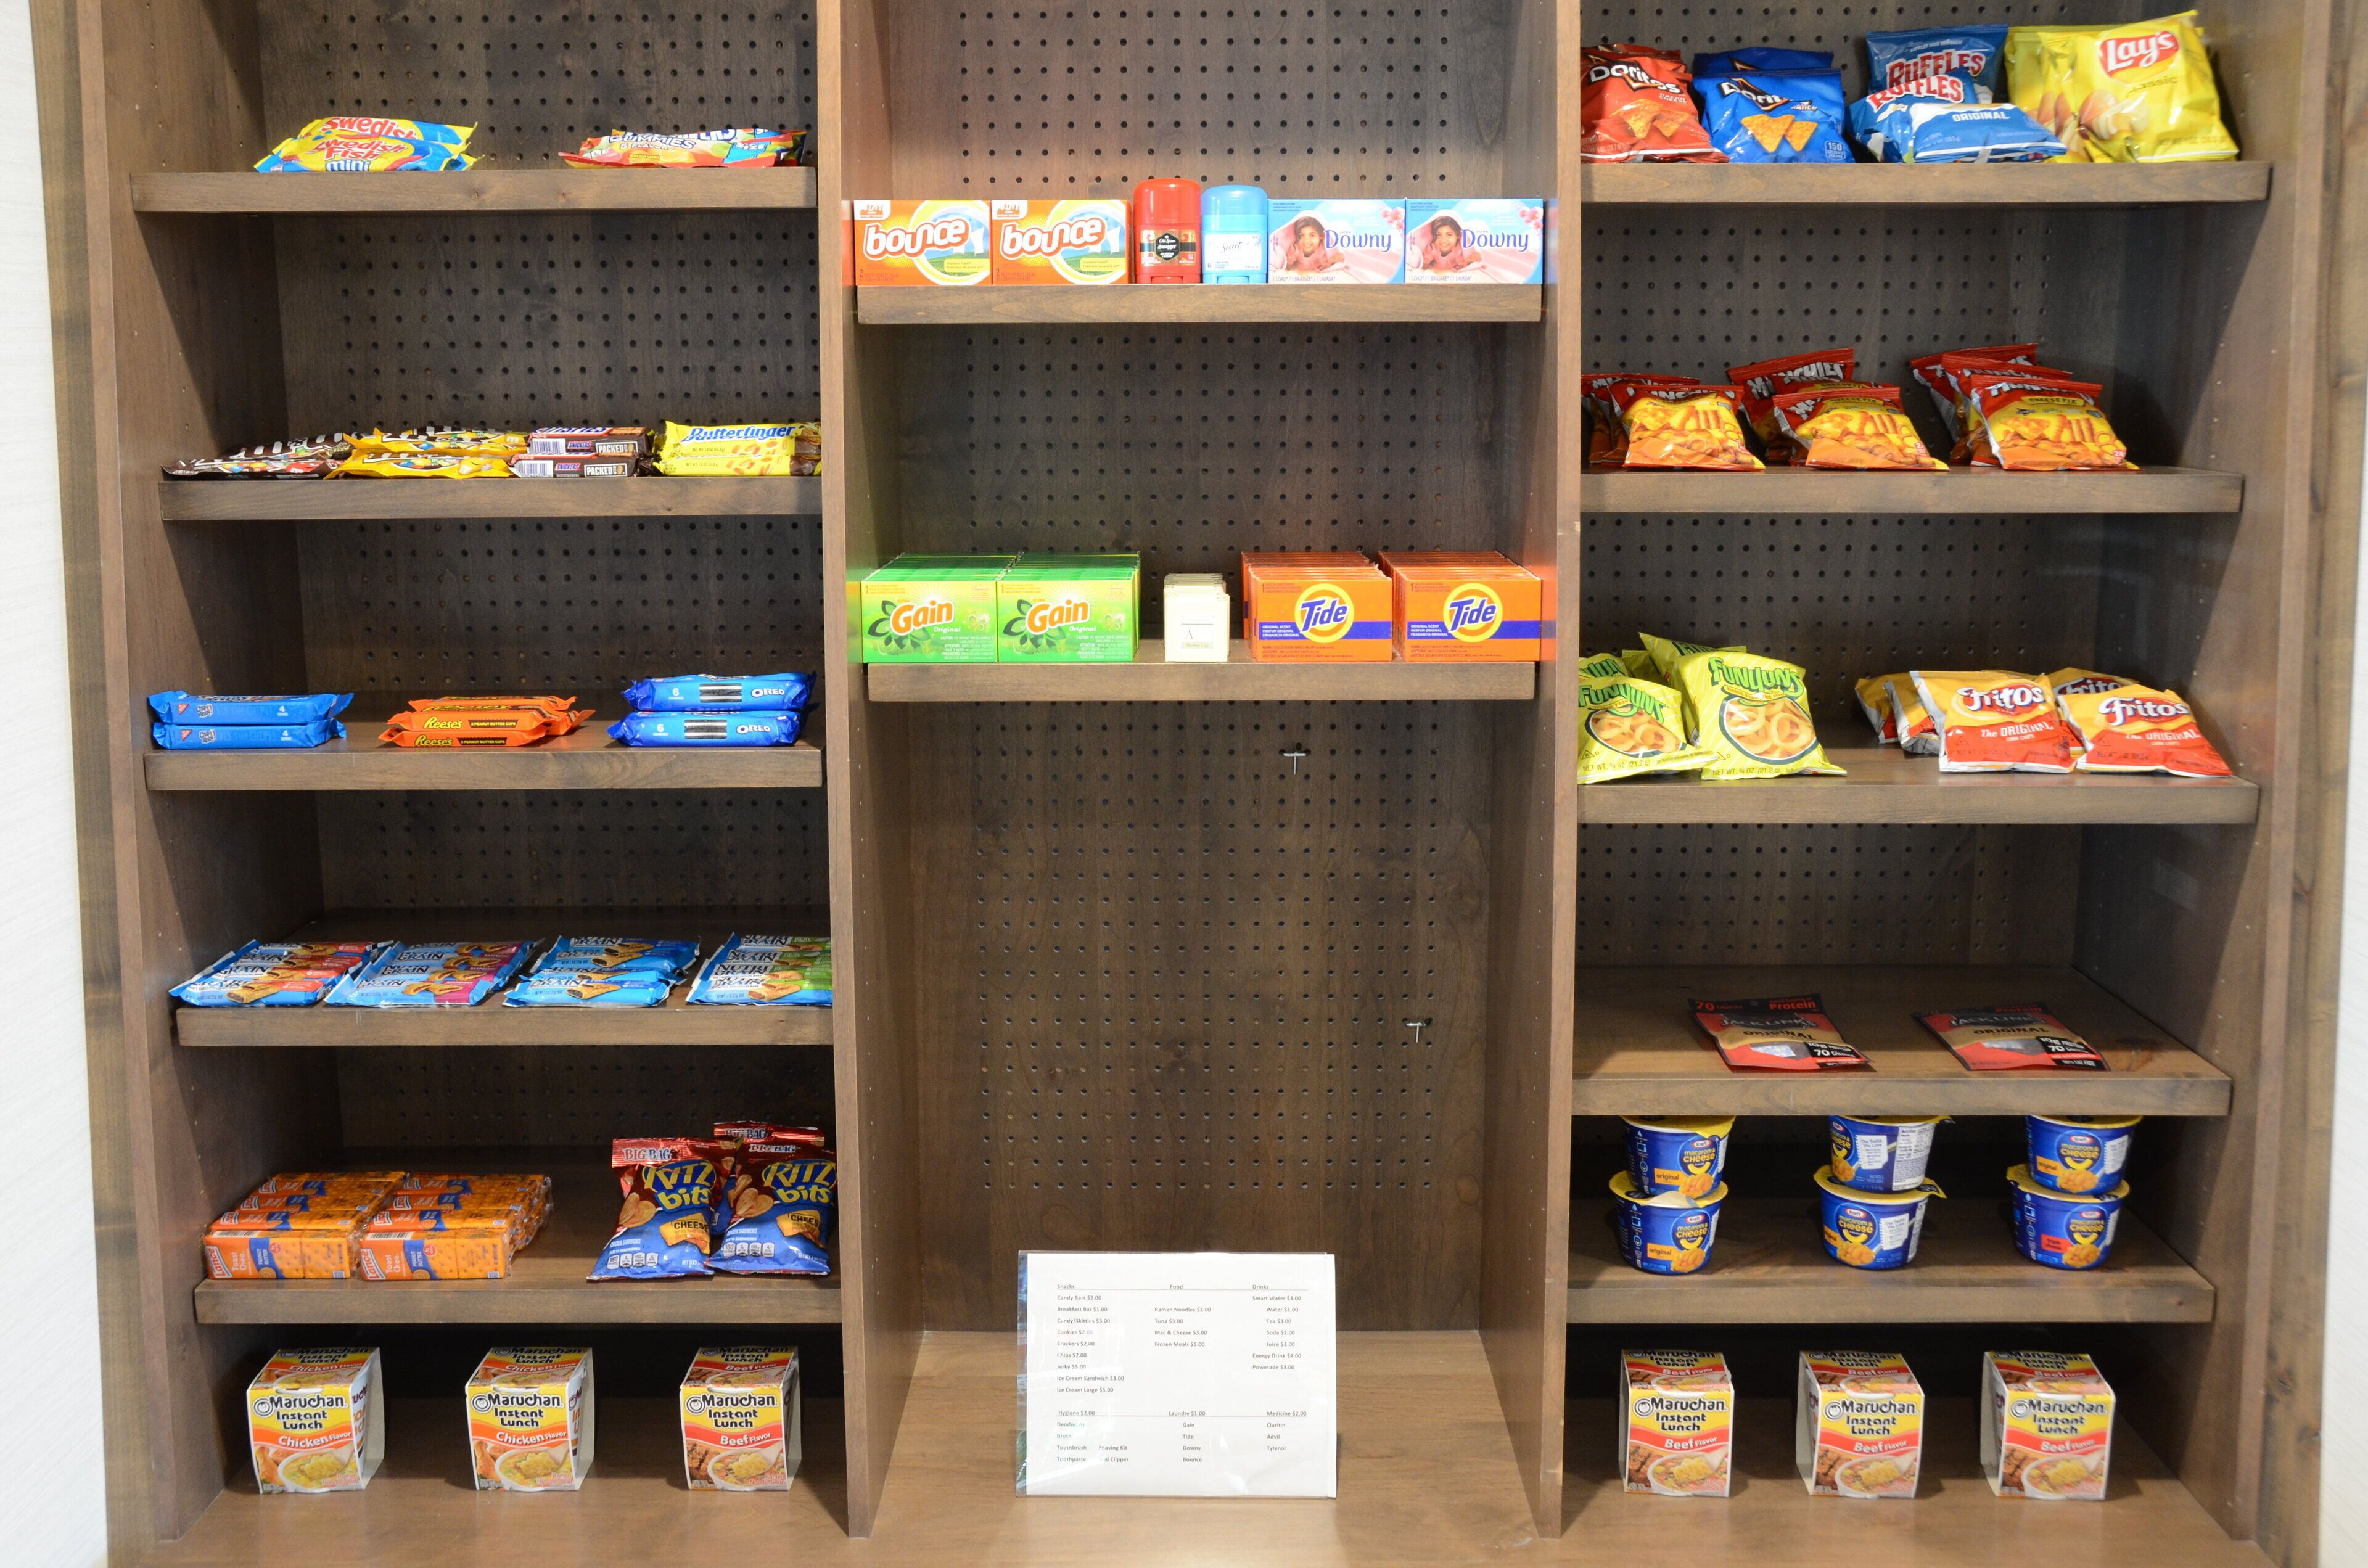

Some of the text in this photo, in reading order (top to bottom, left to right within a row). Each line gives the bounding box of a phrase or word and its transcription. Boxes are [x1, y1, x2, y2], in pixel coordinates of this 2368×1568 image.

[2106, 31, 2176, 72] Lay's
[1589, 64, 1684, 94] Doritos
[1952, 111, 2010, 123] ORIGINAL
[310, 138, 408, 154] Swedish
[324, 147, 383, 161] Fish
[325, 160, 371, 172] mini
[866, 218, 968, 257] bounce
[1002, 216, 1104, 257] bounce
[1325, 229, 1392, 252] Downy
[1462, 229, 1529, 252] Downy
[681, 425, 797, 442] Butterfinger
[598, 443, 624, 453] PACKED
[586, 466, 612, 476] PACKED
[892, 599, 953, 634] Gain
[1027, 599, 1089, 633] Gain
[1300, 598, 1349, 633] Tide
[1449, 597, 1497, 632] Tide
[1708, 656, 1804, 700] FUNYUNS
[750, 688, 786, 699] OREO
[1956, 686, 2046, 712] Fritos
[2098, 696, 2191, 726] Fritos
[423, 715, 464, 729] Reese's
[1980, 721, 2055, 737] The ORIGINAL
[736, 724, 771, 735] OREO
[414, 734, 453, 747] Reese's
[1768, 1000, 1817, 1011] Protein
[1742, 1030, 1818, 1041] ORIGINAL
[1973, 1025, 2050, 1035] ORIGINAL
[623, 1147, 672, 1160] BIG BAG
[749, 1144, 771, 1152] BIG
[644, 1162, 715, 1190] RITZ
[764, 1162, 837, 1187] RITZ
[1656, 1173, 1680, 1183] original
[657, 1186, 711, 1210] bits
[777, 1185, 831, 1204] bits
[673, 1221, 709, 1232] CHEESE
[1649, 1247, 1672, 1256] original
[208, 1247, 226, 1278] Lance
[361, 1249, 381, 1280] Lance
[270, 1395, 344, 1409] Maruchan
[487, 1394, 561, 1407] Maruchan
[701, 1394, 775, 1407] Maruchan
[1651, 1397, 1725, 1411] Maruchan
[1841, 1398, 1916, 1414] Maruchan
[2028, 1398, 2106, 1414] Maruchan
[277, 1410, 327, 1421] Instant
[495, 1408, 544, 1418] Instant
[709, 1409, 758, 1419] Instant
[1656, 1413, 1707, 1422] Instant
[283, 1421, 323, 1430] Lunch
[501, 1418, 540, 1427] Lunch
[714, 1419, 754, 1428] Lunch
[1661, 1422, 1701, 1432] Lunch
[1846, 1415, 1897, 1426] Instant
[1851, 1425, 1891, 1435] Lunch
[279, 1432, 352, 1448] Chicken Flavor
[496, 1431, 567, 1445] Chicken Flavor
[720, 1432, 771, 1447] Beef Flavor
[1665, 1436, 1718, 1450] Beef Flavor
[1854, 1441, 1884, 1453] Beef
